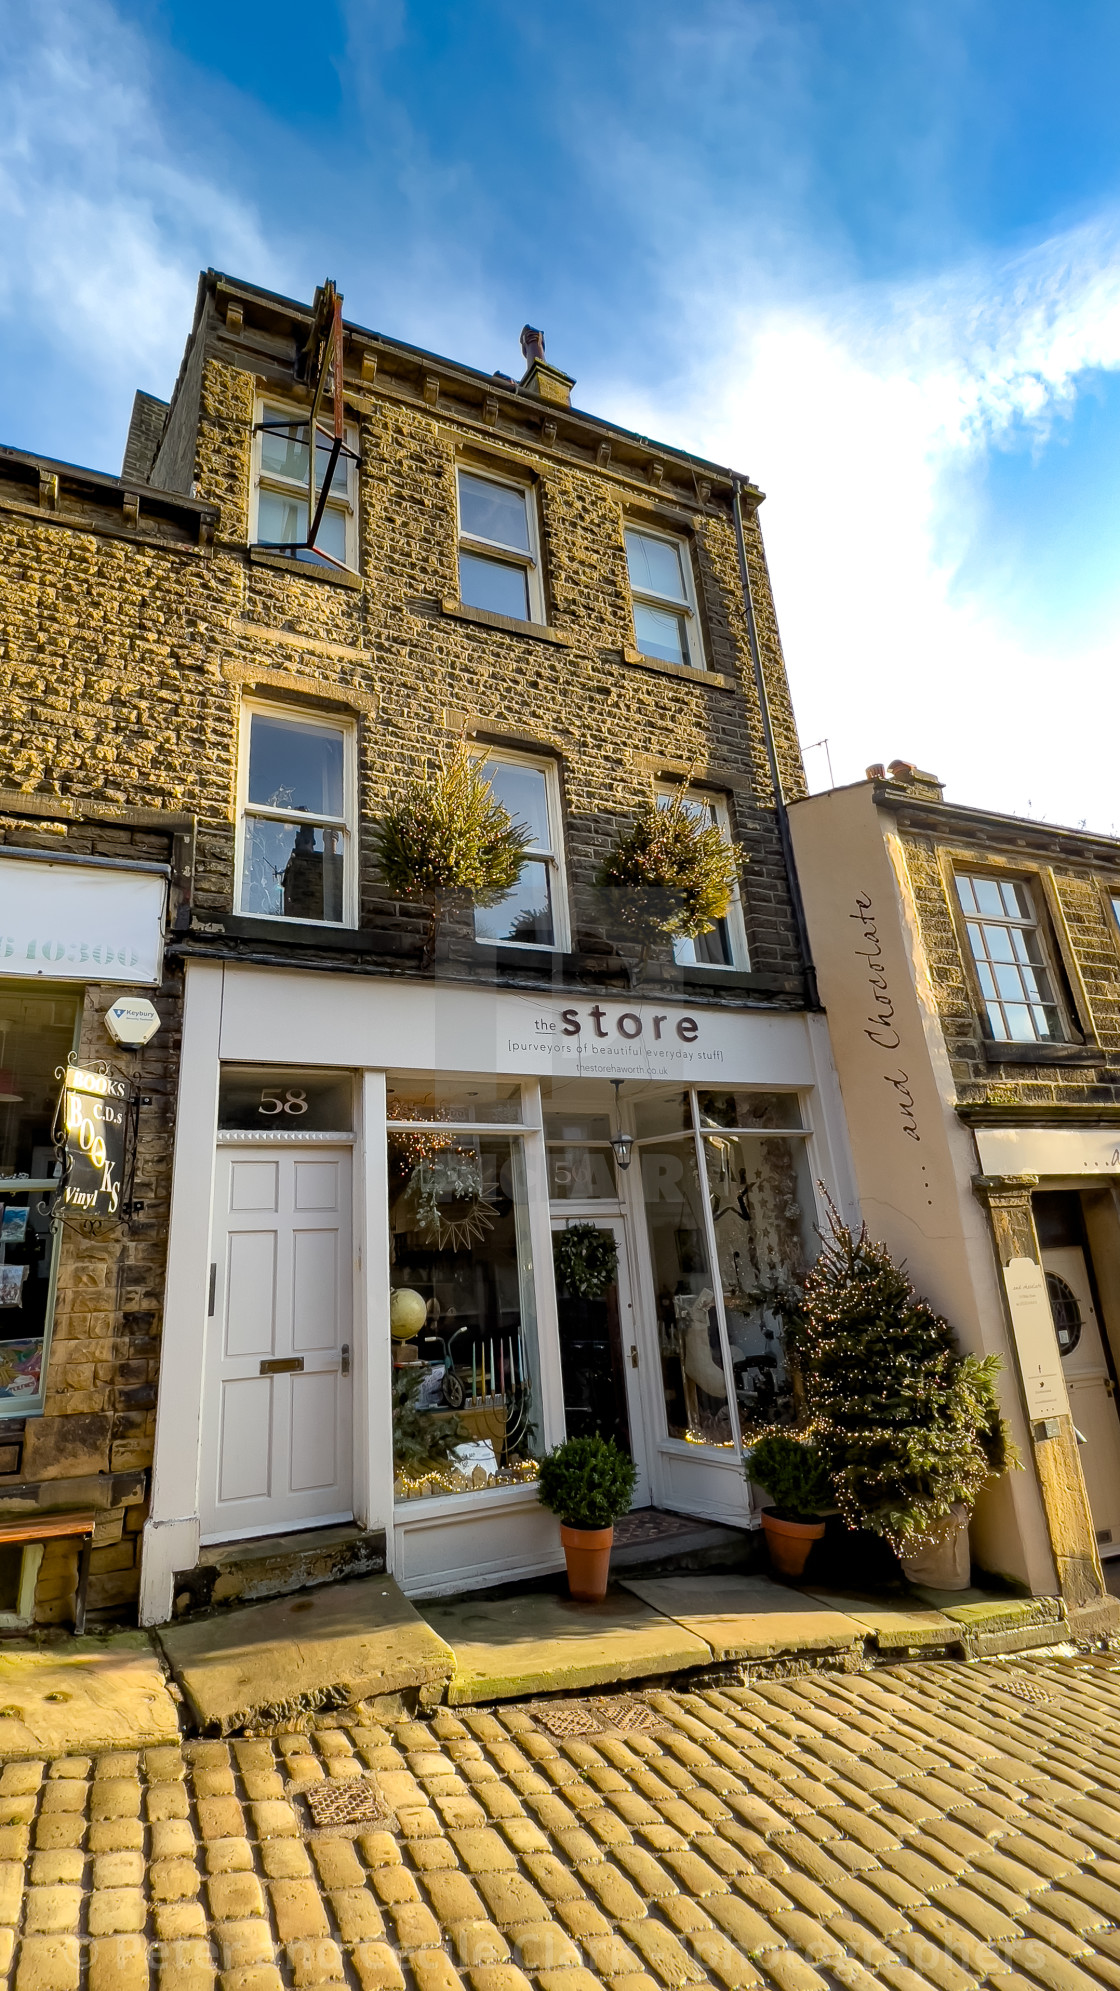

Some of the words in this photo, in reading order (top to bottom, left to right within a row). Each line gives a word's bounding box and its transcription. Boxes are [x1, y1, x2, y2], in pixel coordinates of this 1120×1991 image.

[850, 890, 901, 1050] Chocolate
[126, 1009, 155, 1018] Keybury
[534, 1018, 556, 1031] the
[561, 1004, 699, 1043] store
[576, 1043, 588, 1054] of
[592, 1043, 642, 1055] beautiful
[646, 1049, 694, 1061] everyday
[576, 1063, 668, 1075] thestorehaworth.co.uk
[73, 1070, 125, 1097] BOOKS
[258, 1087, 309, 1115] 58
[883, 1068, 921, 1141] and
[69, 1095, 121, 1214] BOOKS
[65, 1186, 99, 1210] Vinyl
